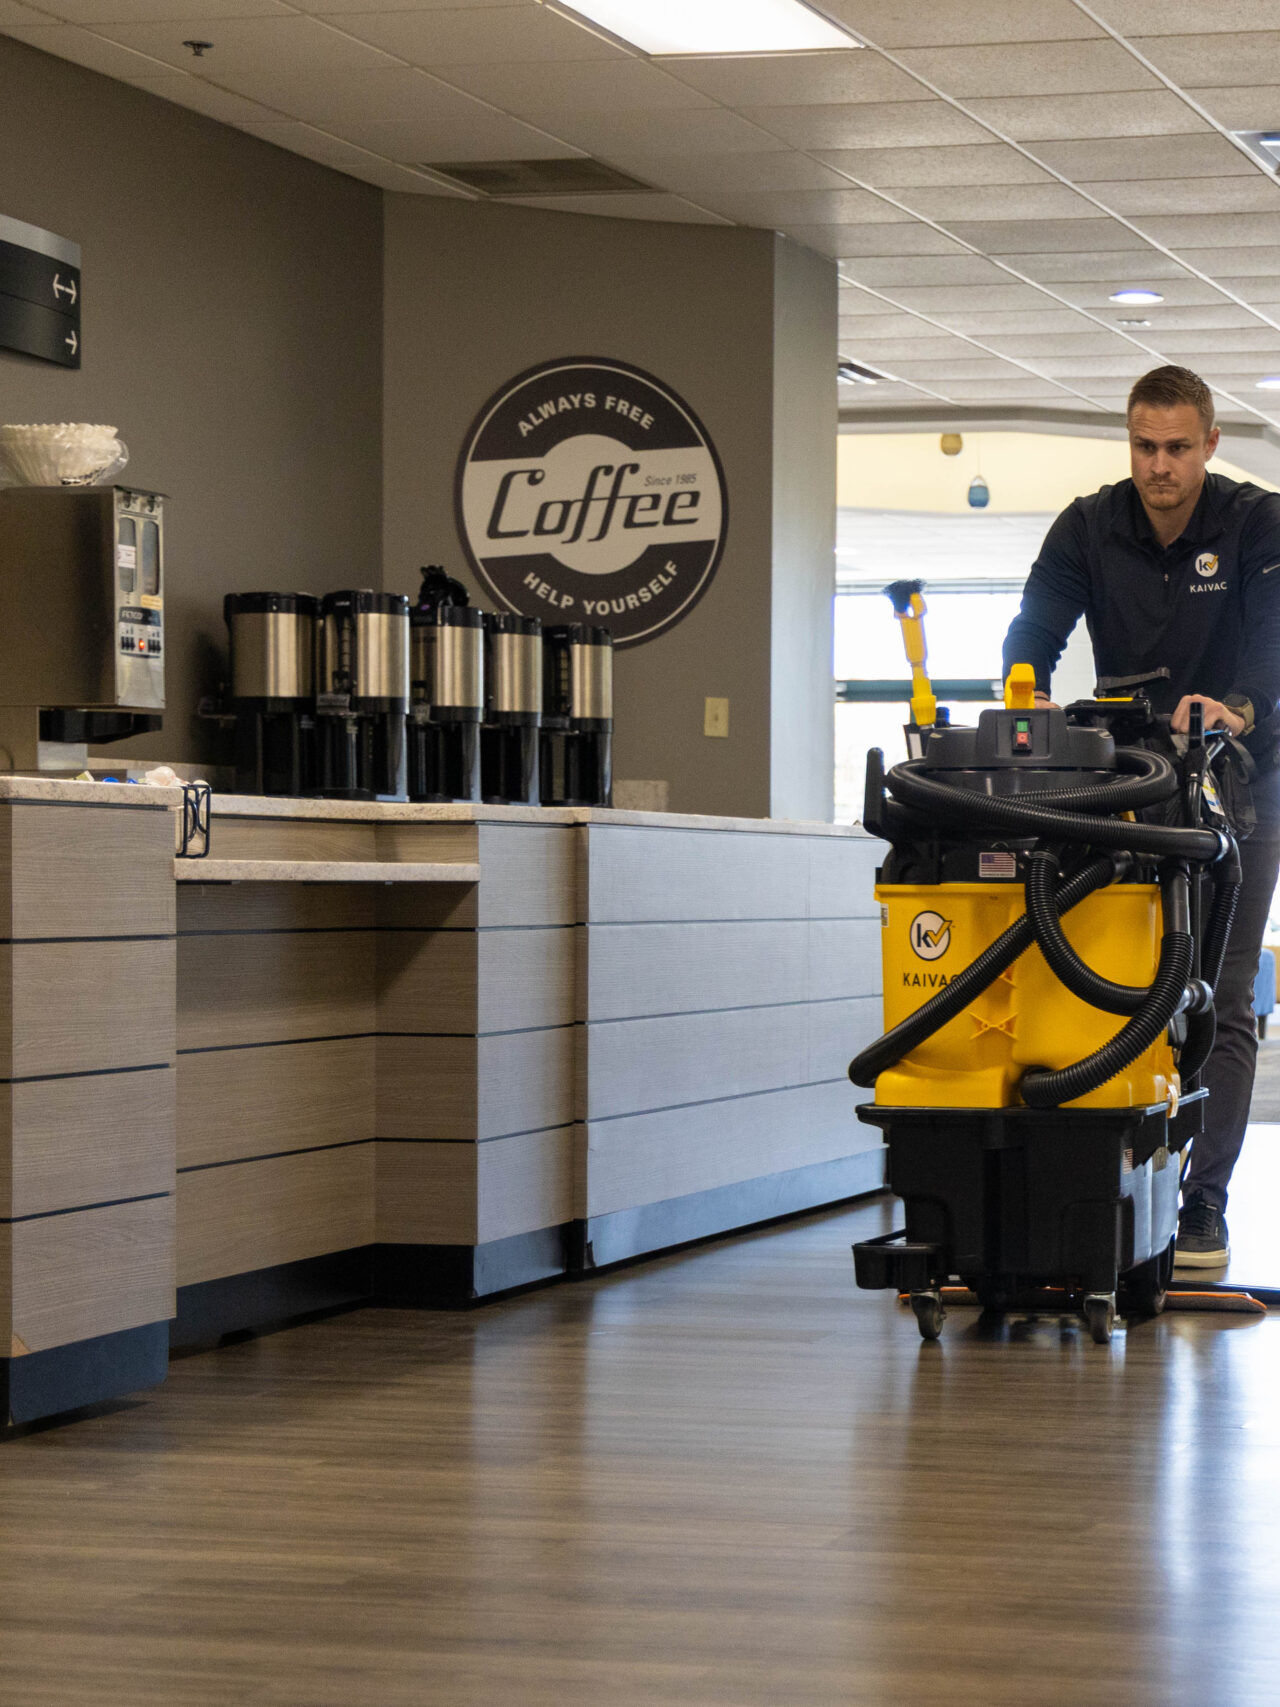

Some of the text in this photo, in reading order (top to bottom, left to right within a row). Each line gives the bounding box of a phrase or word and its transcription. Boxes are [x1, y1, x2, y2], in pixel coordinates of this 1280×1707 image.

[517, 393, 655, 437] ALWAYS FREE
[644, 475, 672, 487] Since
[486, 463, 701, 544] Coffee
[523, 560, 679, 616] HELP YOURSELF
[1189, 581, 1228, 593] KAIVAC
